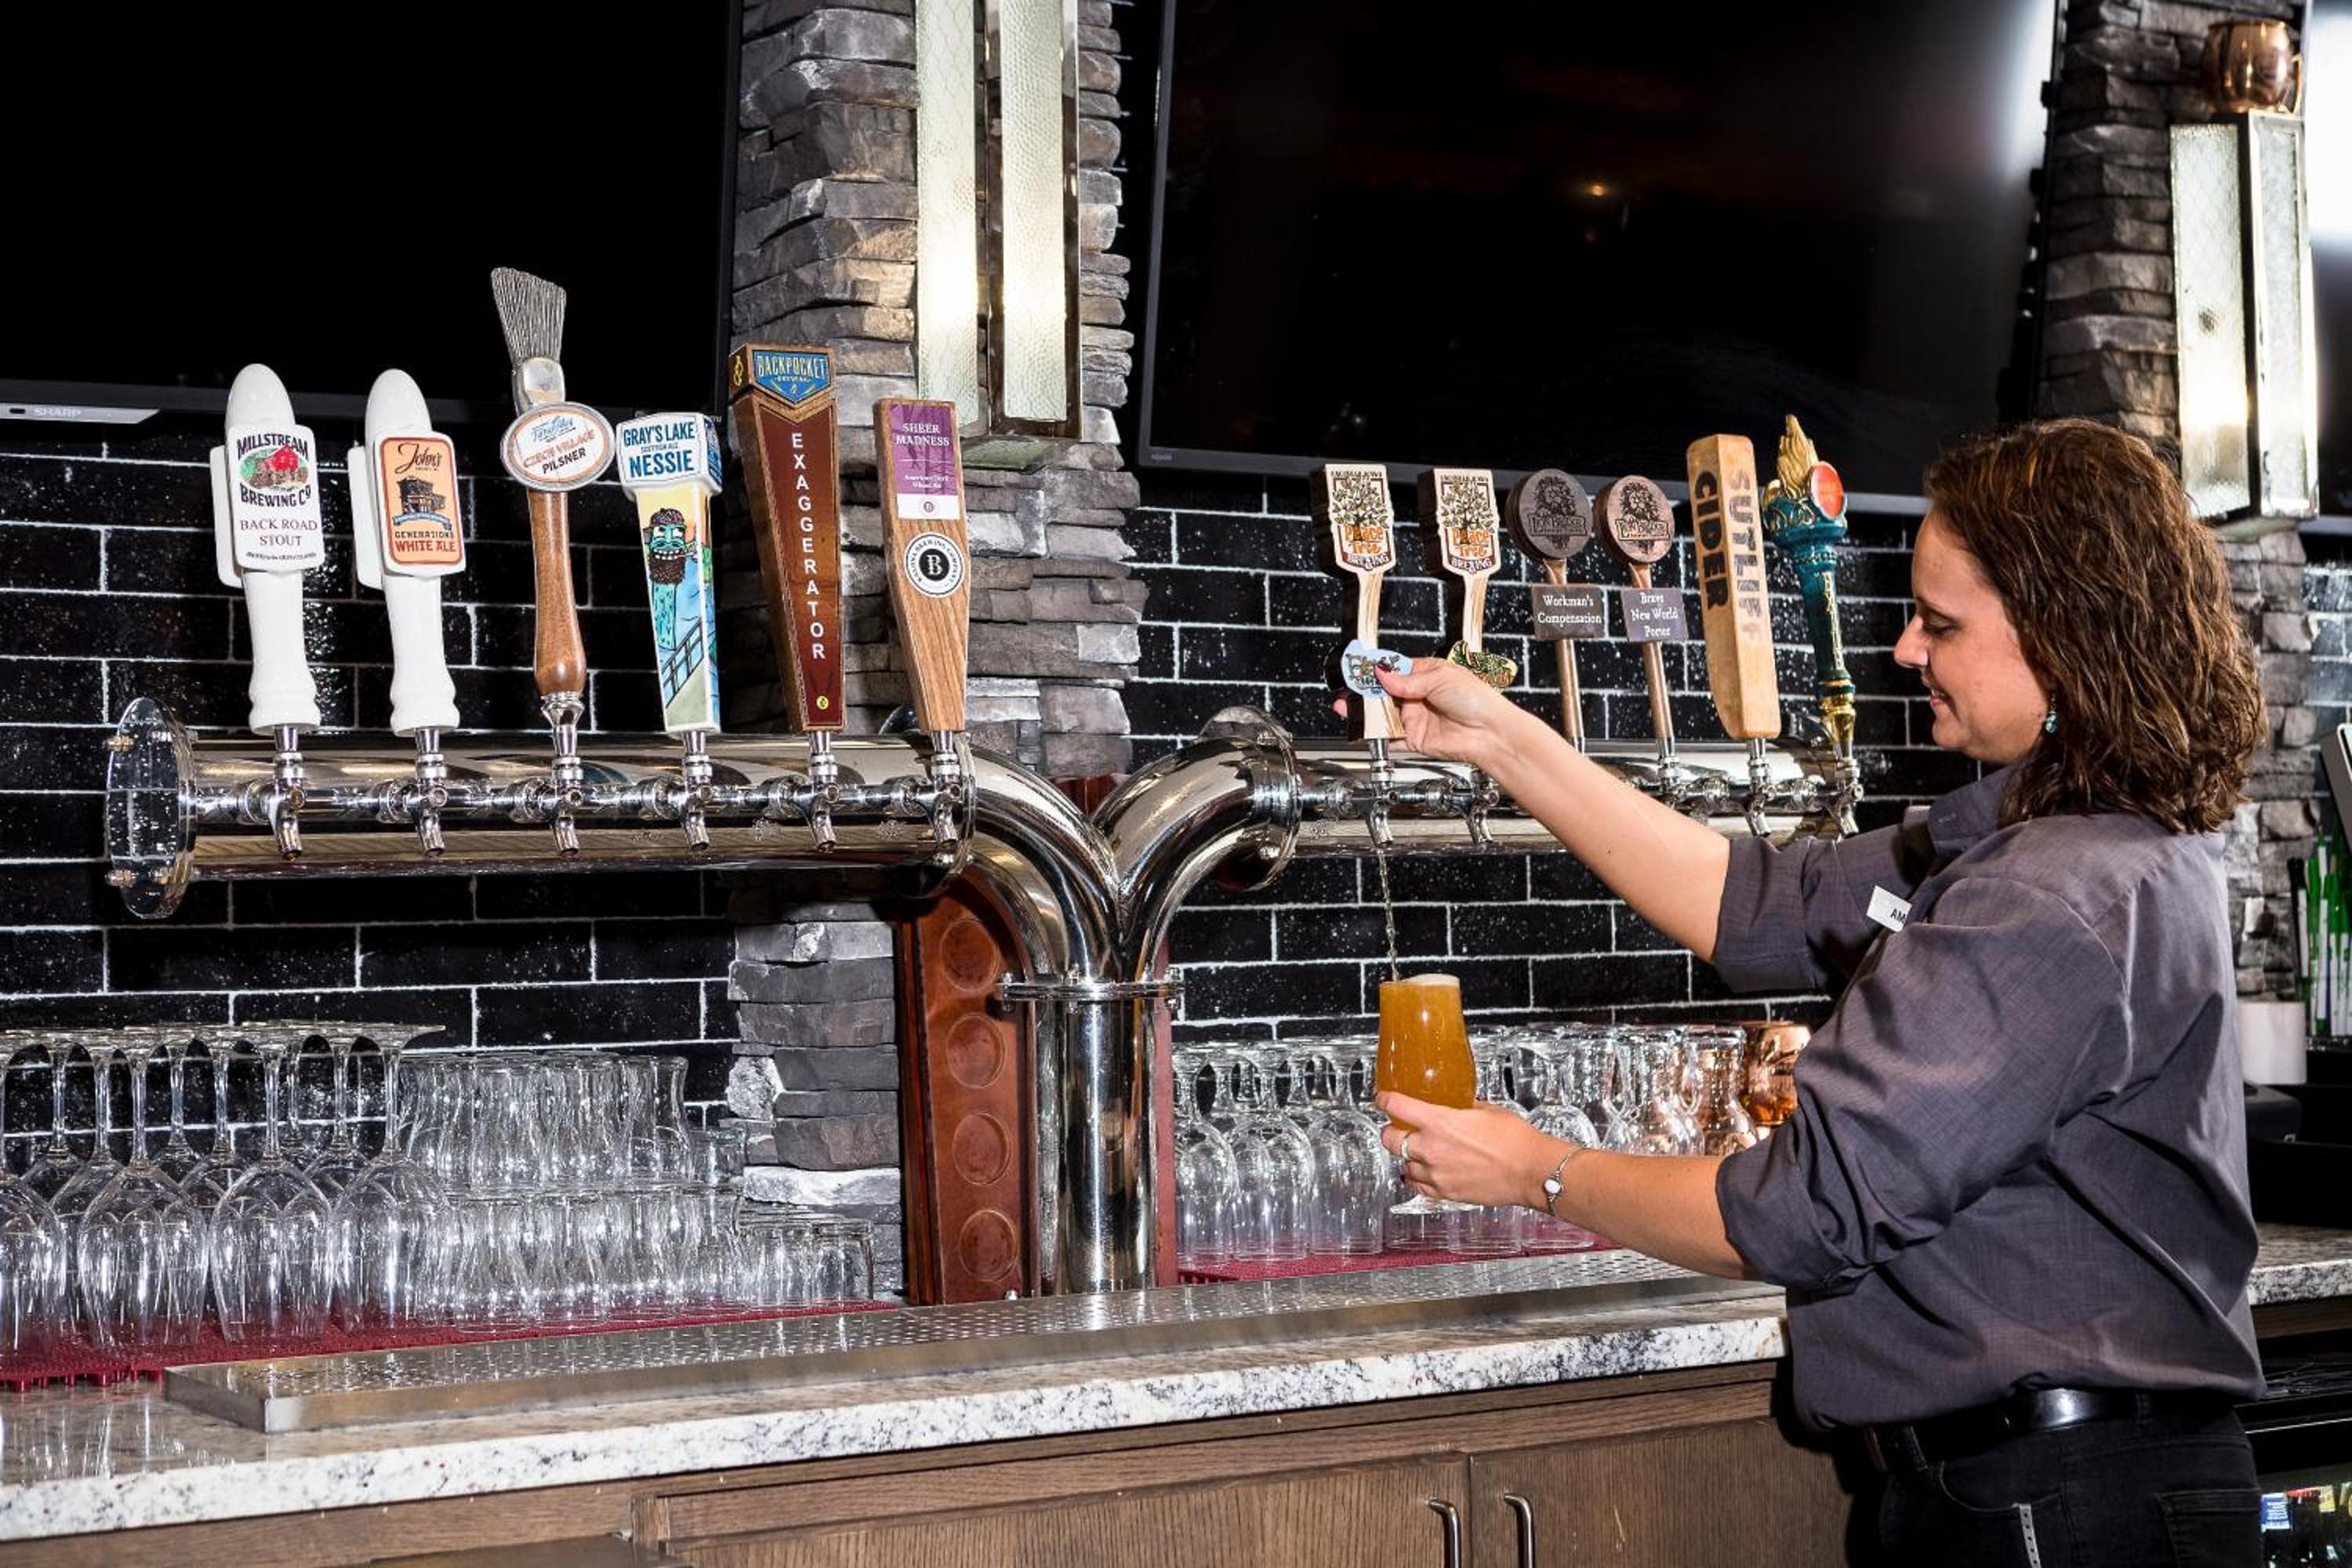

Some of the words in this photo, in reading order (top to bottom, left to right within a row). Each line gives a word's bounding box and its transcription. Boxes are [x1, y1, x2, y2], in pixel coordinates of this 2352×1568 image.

[757, 355, 826, 379] BACKPOCKET
[34, 408, 82, 418] SHARP
[623, 424, 663, 447] GRAY'S
[664, 421, 695, 441] LAKE
[903, 423, 939, 434] SHEER
[237, 434, 309, 461] MILLSTREAM
[896, 434, 949, 446] MADNESS
[542, 446, 586, 474] PILSNER
[629, 449, 694, 478] NESSIE
[240, 482, 297, 507] BREWING
[240, 519, 277, 531] BACK
[281, 518, 318, 531] ROAD
[260, 535, 302, 546] STOUT
[394, 530, 455, 539] GENERATIONS
[1345, 525, 1384, 541] Peace
[1452, 526, 1490, 545] Peace
[394, 540, 434, 552] WHITE
[435, 540, 456, 552] ALE
[791, 432, 826, 659] EXAGGERATOR
[1348, 543, 1381, 554] Tree
[1694, 472, 1728, 610] CIDER
[1455, 546, 1487, 557] Tree
[1543, 593, 1594, 607] Workman's
[1537, 611, 1602, 628] Compensation
[1631, 609, 1651, 621] New
[1652, 607, 1679, 620] World
